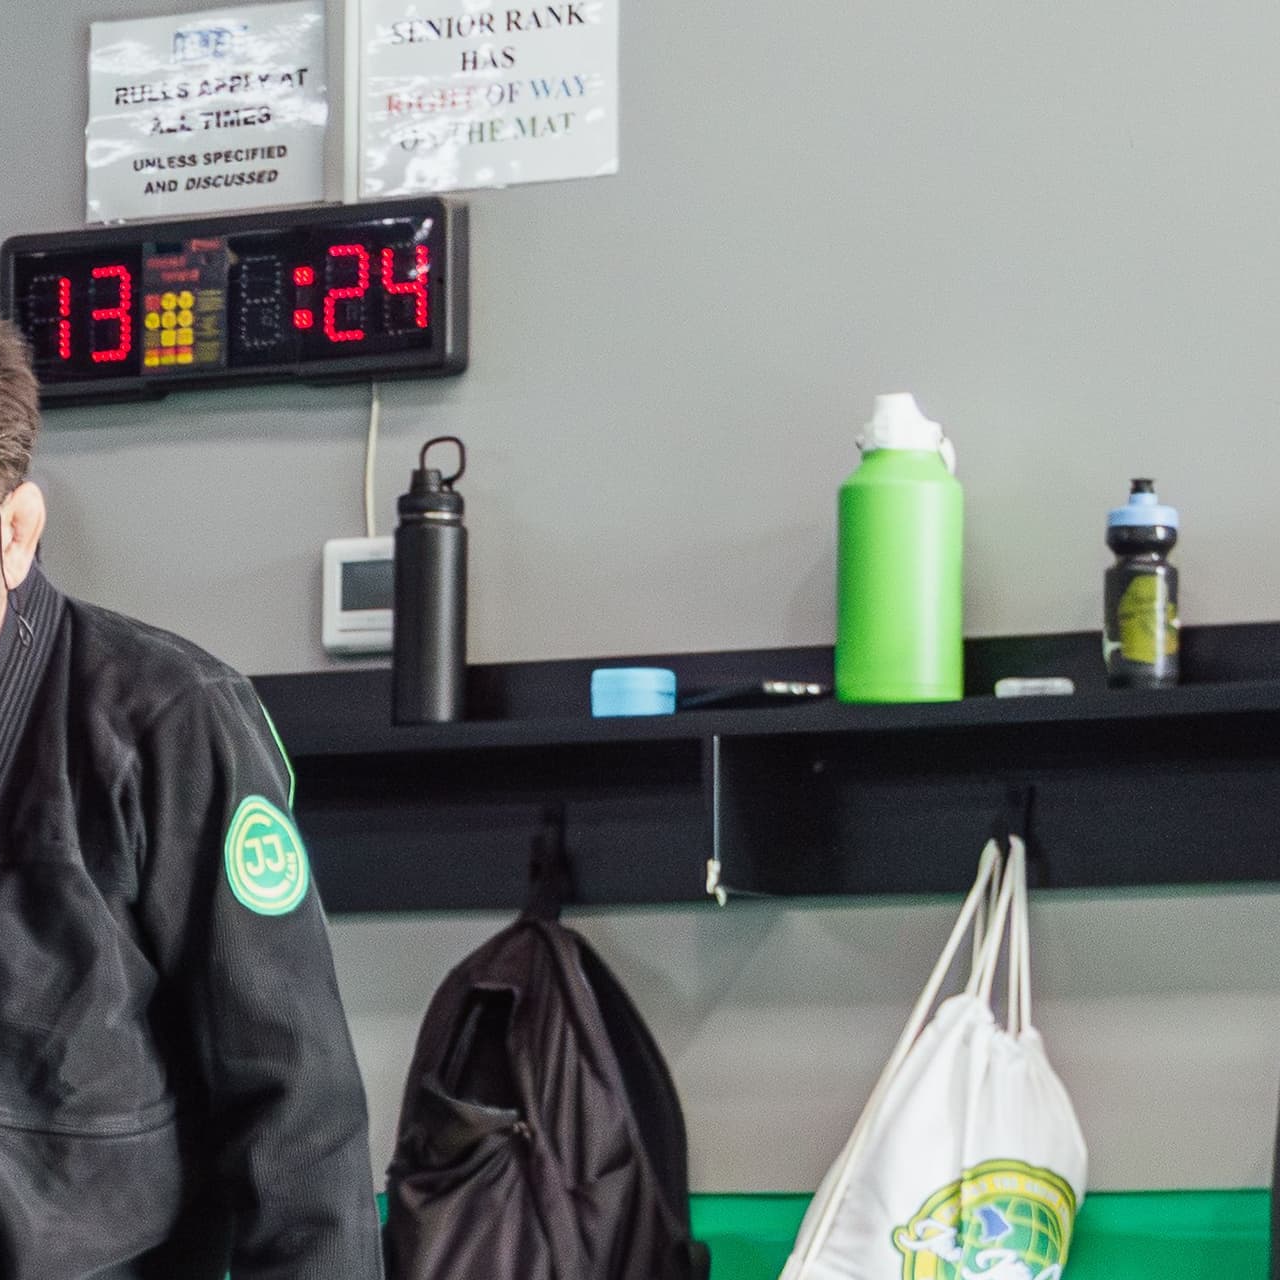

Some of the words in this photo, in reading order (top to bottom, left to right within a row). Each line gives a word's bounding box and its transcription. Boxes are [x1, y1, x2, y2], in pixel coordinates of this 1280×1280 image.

[391, 12, 495, 45] SENIOR
[506, 4, 586, 33] RANK
[461, 46, 516, 71] HAS
[114, 83, 189, 106] RULES
[197, 74, 270, 98] APPLY
[280, 68, 309, 87] AT
[386, 85, 477, 113] RIGHT
[486, 82, 523, 105] OF
[530, 75, 587, 99] WAY
[150, 115, 193, 136] ALL
[199, 106, 272, 130] TIMES
[450, 119, 505, 144] THE
[514, 112, 576, 139] MAT
[133, 154, 197, 172] UNLESS
[203, 145, 288, 166] SPECIFIED
[144, 180, 178, 195] AND
[185, 170, 278, 191] DISCUSSED
